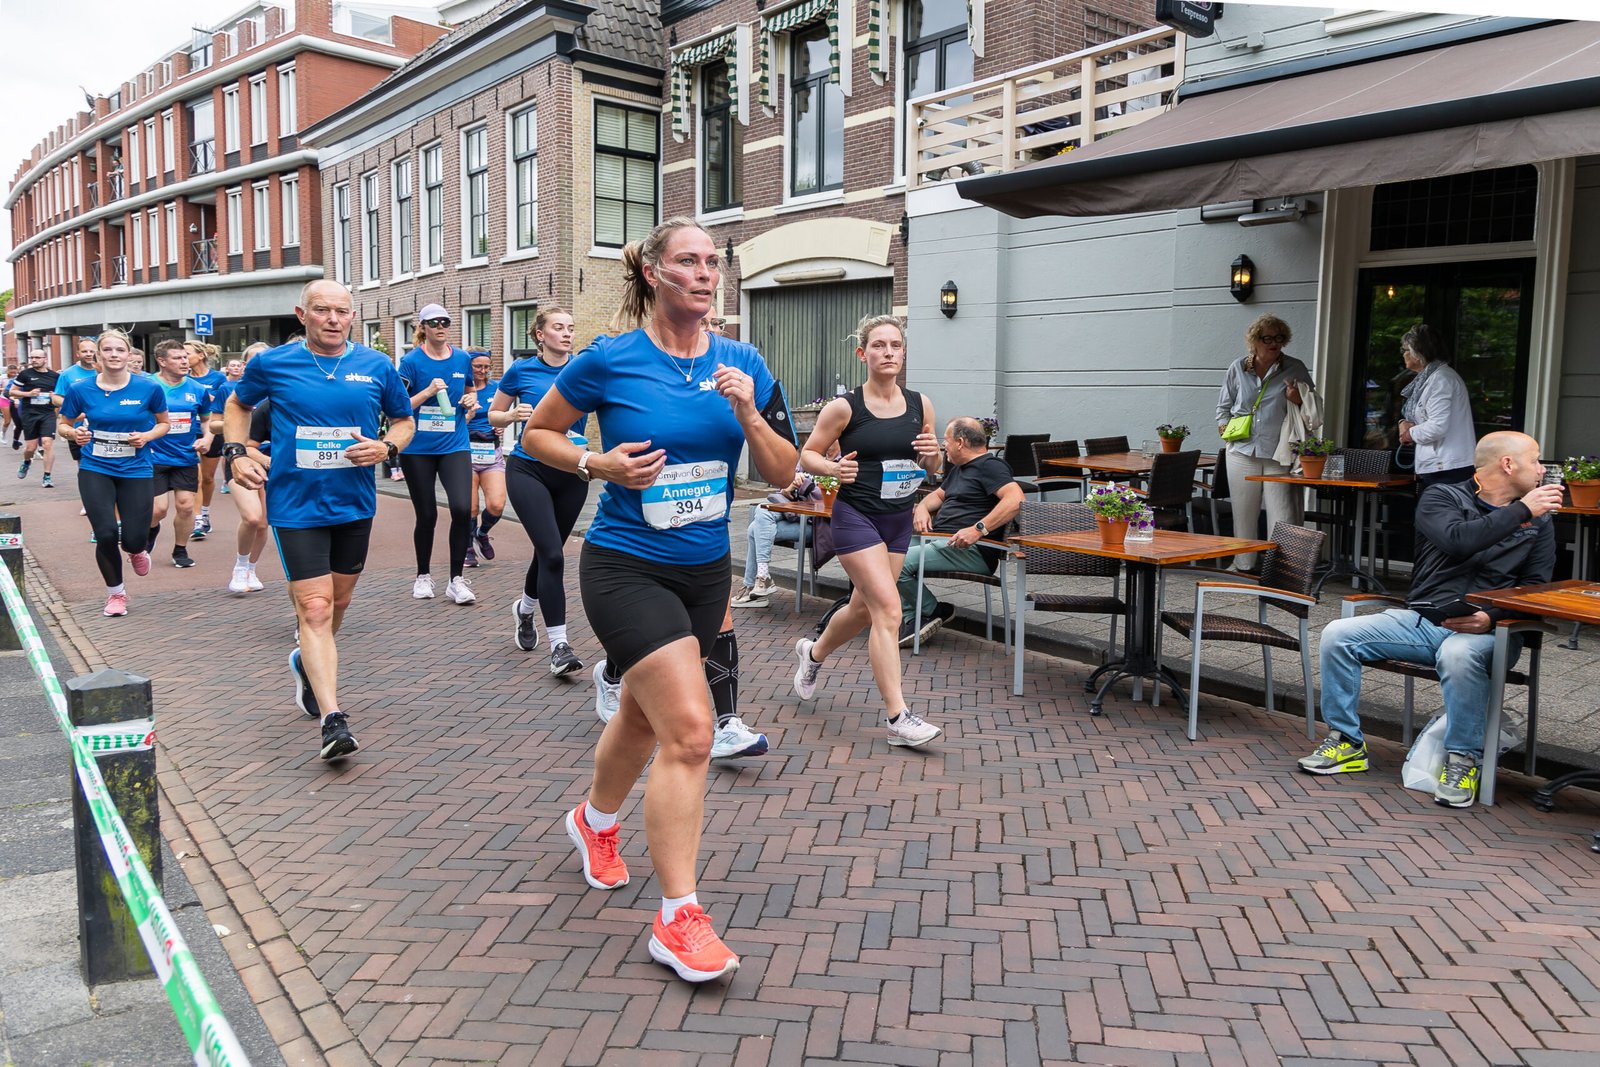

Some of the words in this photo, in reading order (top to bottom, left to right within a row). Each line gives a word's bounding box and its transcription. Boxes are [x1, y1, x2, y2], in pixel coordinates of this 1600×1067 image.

[199, 315, 209, 326] P
[316, 441, 342, 449] Eelke
[318, 451, 339, 460] 891
[662, 483, 711, 499] Annegré
[675, 498, 704, 515] 394
